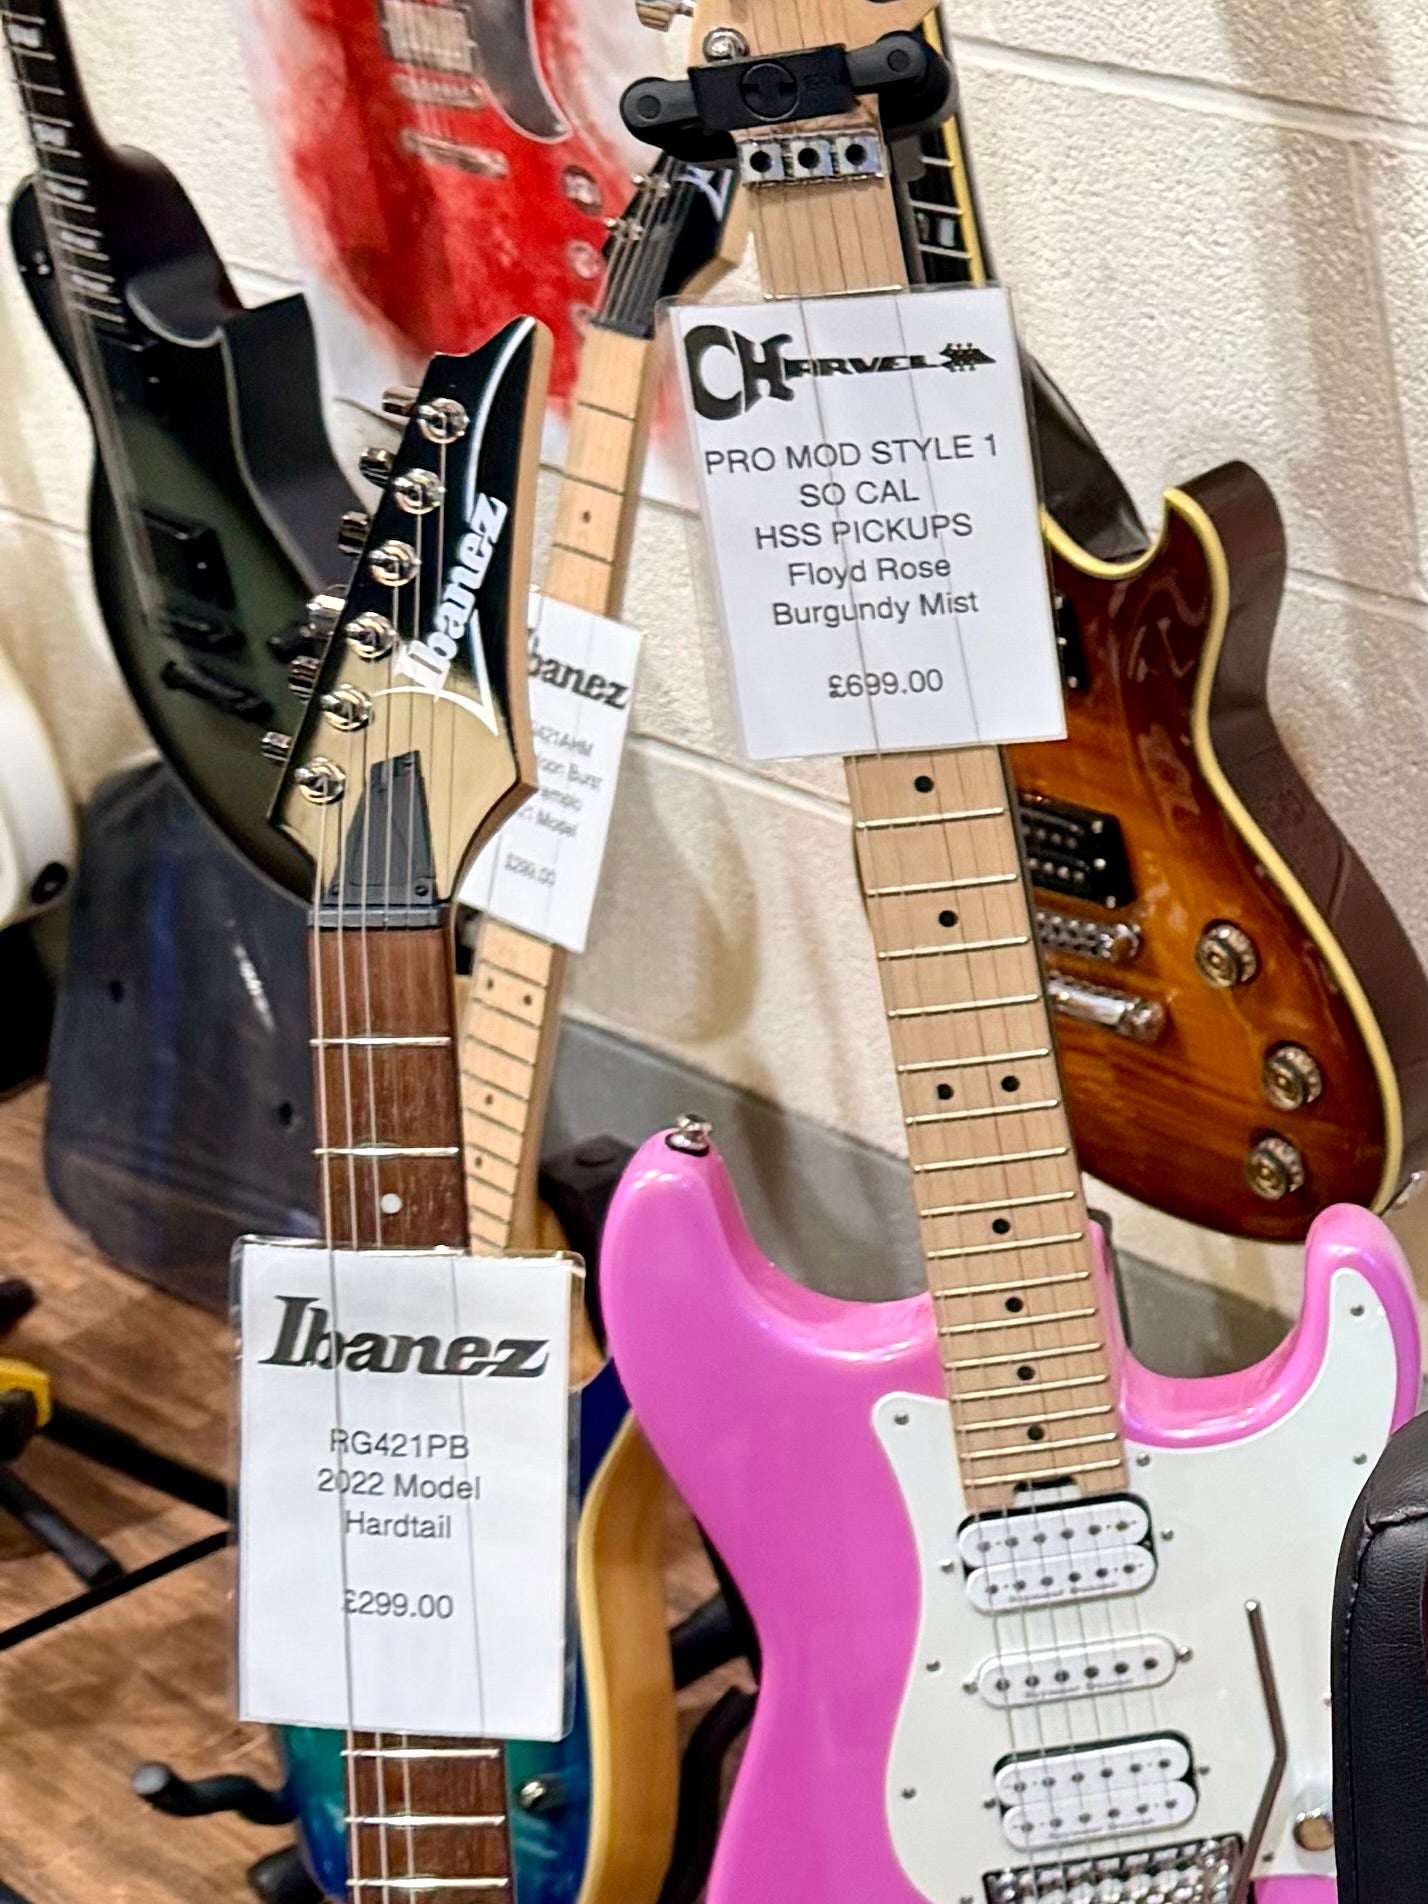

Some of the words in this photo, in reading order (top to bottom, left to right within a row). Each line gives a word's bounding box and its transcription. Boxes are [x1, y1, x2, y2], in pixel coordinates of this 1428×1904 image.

[705, 446, 776, 475] PRO
[786, 441, 862, 470] MOD
[871, 436, 974, 465] STYLE
[984, 433, 999, 457] 1
[799, 482, 847, 508] SO
[856, 479, 920, 505] CAL
[755, 522, 822, 551] HSS
[831, 512, 974, 545] PICKUPS
[788, 558, 867, 588] Floyd
[877, 556, 952, 582] Rose
[393, 493, 508, 703] Ibanez
[773, 596, 910, 629] Burgundy
[919, 593, 980, 618] Mist
[828, 668, 944, 699] £699.00
[258, 1294, 551, 1379] Ibanez
[330, 1428, 470, 1461] RG421PB
[317, 1467, 384, 1496] 2022
[394, 1472, 481, 1501] Model
[344, 1510, 451, 1540] Hardtail
[341, 1589, 453, 1620] £299.00
